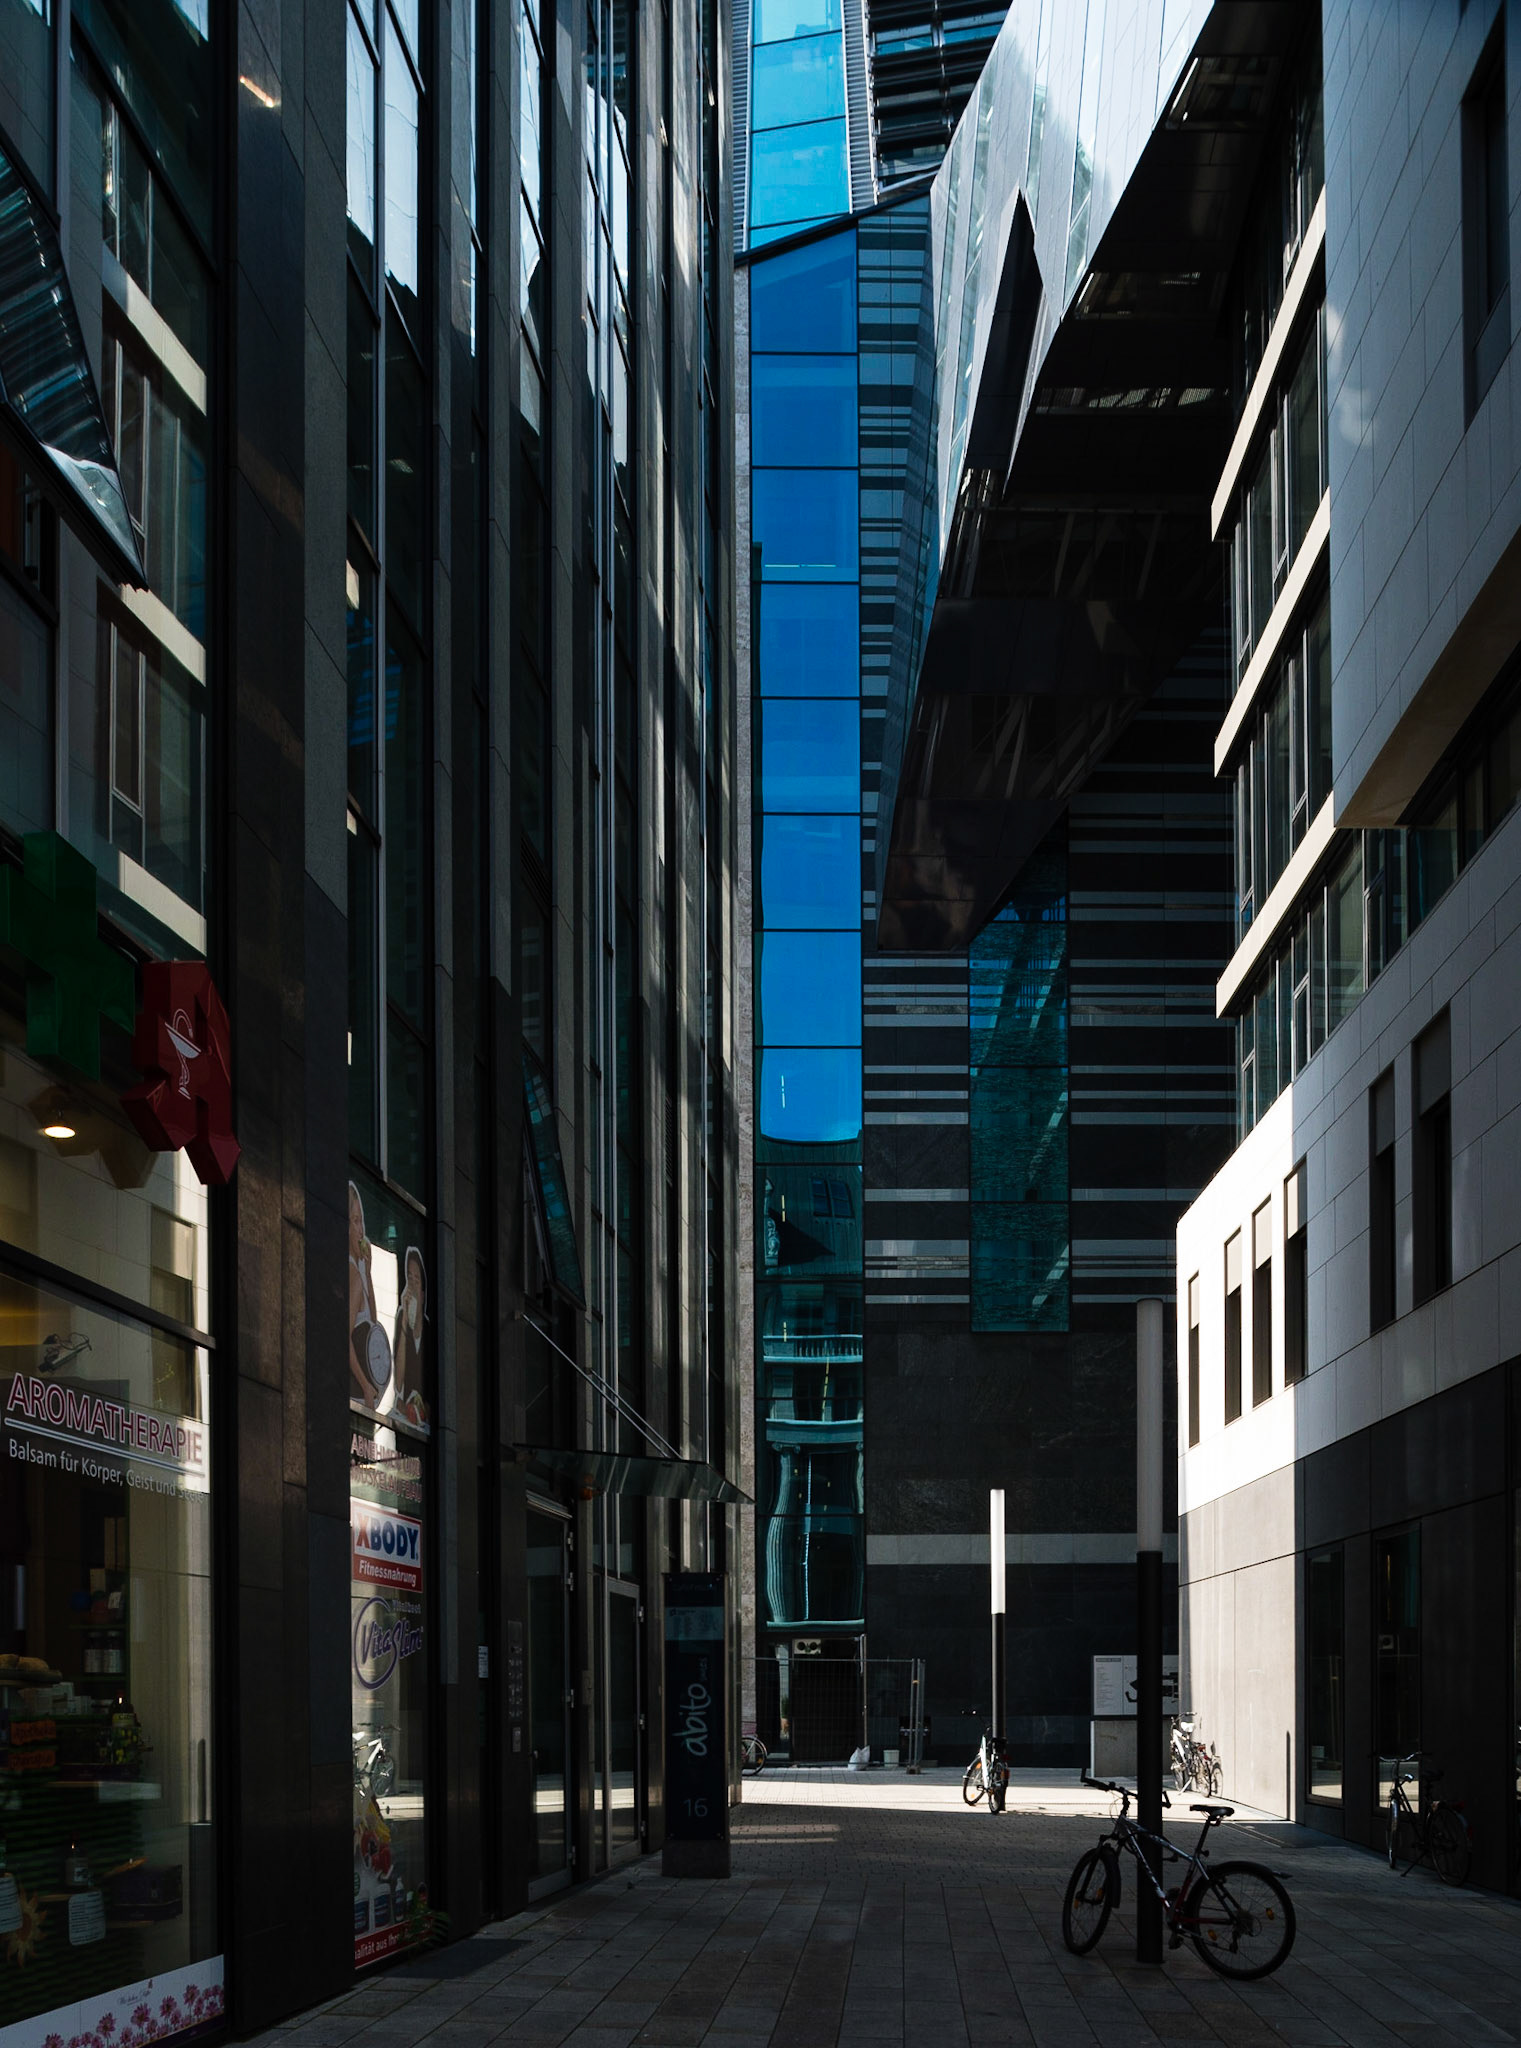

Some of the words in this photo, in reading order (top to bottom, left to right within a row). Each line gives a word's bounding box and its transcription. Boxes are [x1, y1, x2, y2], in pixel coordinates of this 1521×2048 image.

[7, 1372, 203, 1465] AROMATHERAPIE
[9, 1438, 57, 1468] Balsam
[60, 1451, 79, 1473] für
[81, 1456, 124, 1487] Körper,
[126, 1469, 154, 1493] Geist
[156, 1477, 176, 1496] und
[356, 1512, 418, 1560] XBODY
[359, 1560, 417, 1588] Fitnessnahrung
[683, 1798, 709, 1818] 16
[375, 1938, 388, 1952] aus
